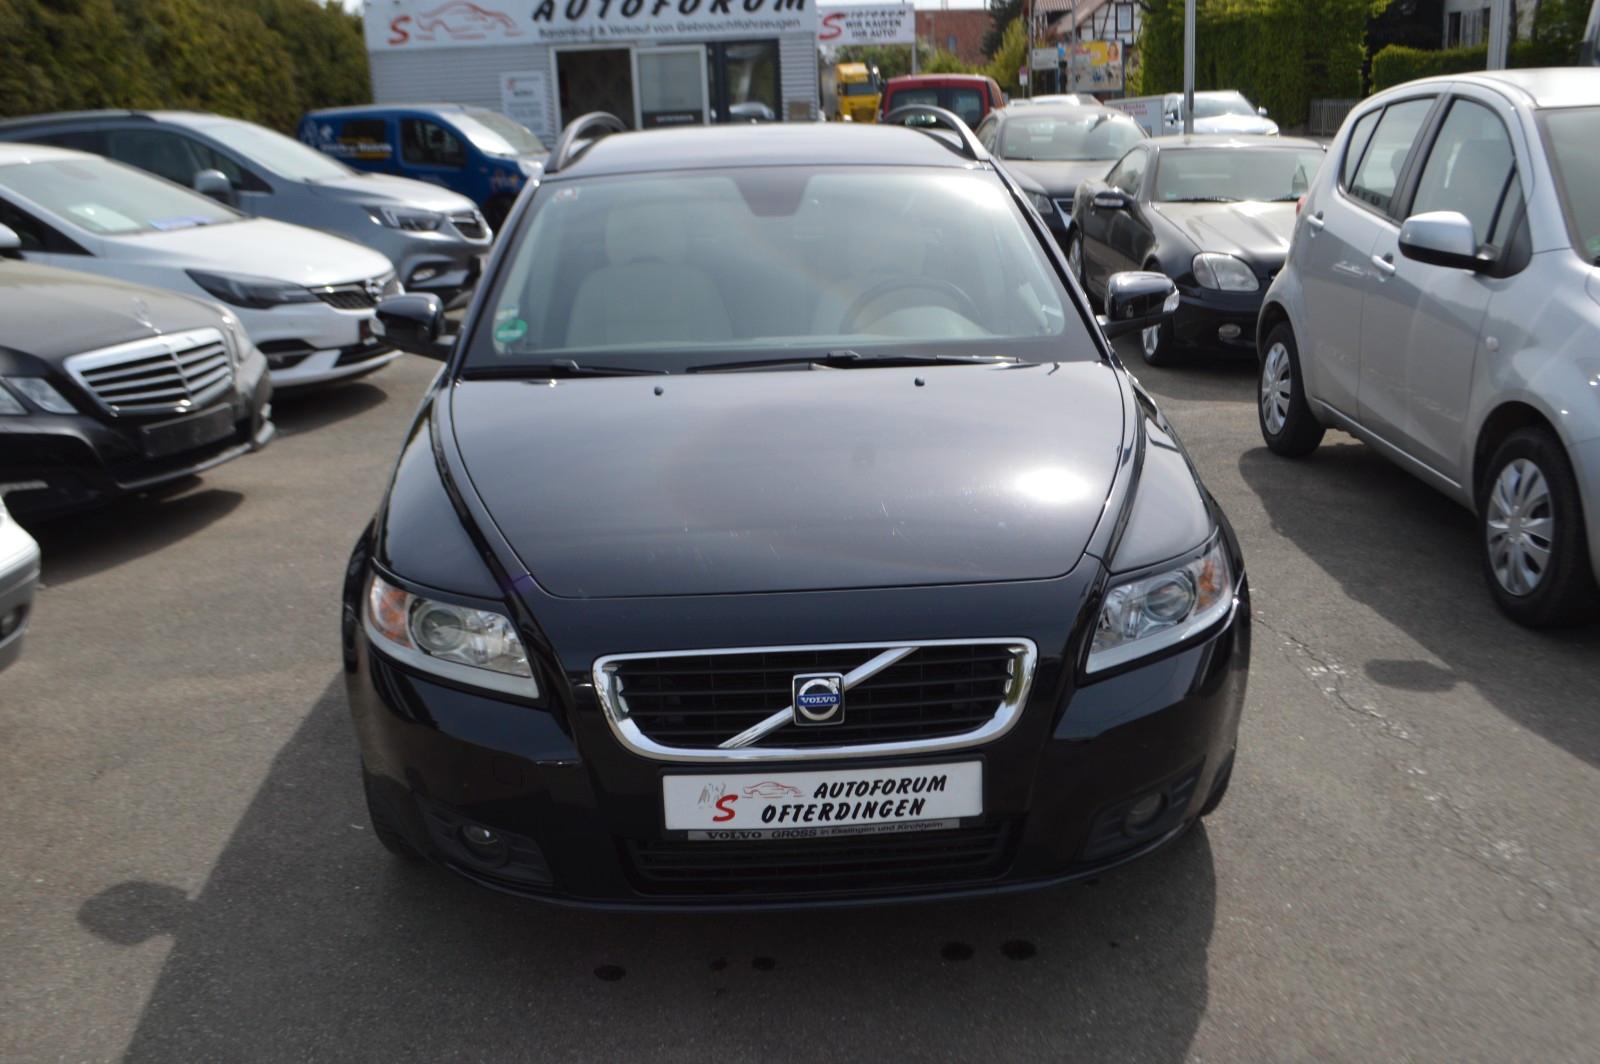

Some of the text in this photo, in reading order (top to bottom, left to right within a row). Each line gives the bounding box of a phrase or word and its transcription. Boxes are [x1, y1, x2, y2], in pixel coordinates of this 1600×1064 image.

[840, 10, 906, 18] TOFORUM
[845, 20, 902, 29] WIR KAUFEN
[387, 15, 412, 46] S
[608, 23, 651, 35] Verkauf
[653, 23, 674, 33] von
[817, 12, 846, 40] S
[800, 696, 837, 704] VOLVO
[813, 774, 947, 799] AUTOFORUM
[712, 794, 738, 822] S
[761, 798, 926, 823] OFTERDINGEN
[706, 831, 762, 839] VOLVO
[771, 829, 817, 838] GROSS
[877, 824, 895, 832] und
[897, 821, 943, 831] Kirchheim
